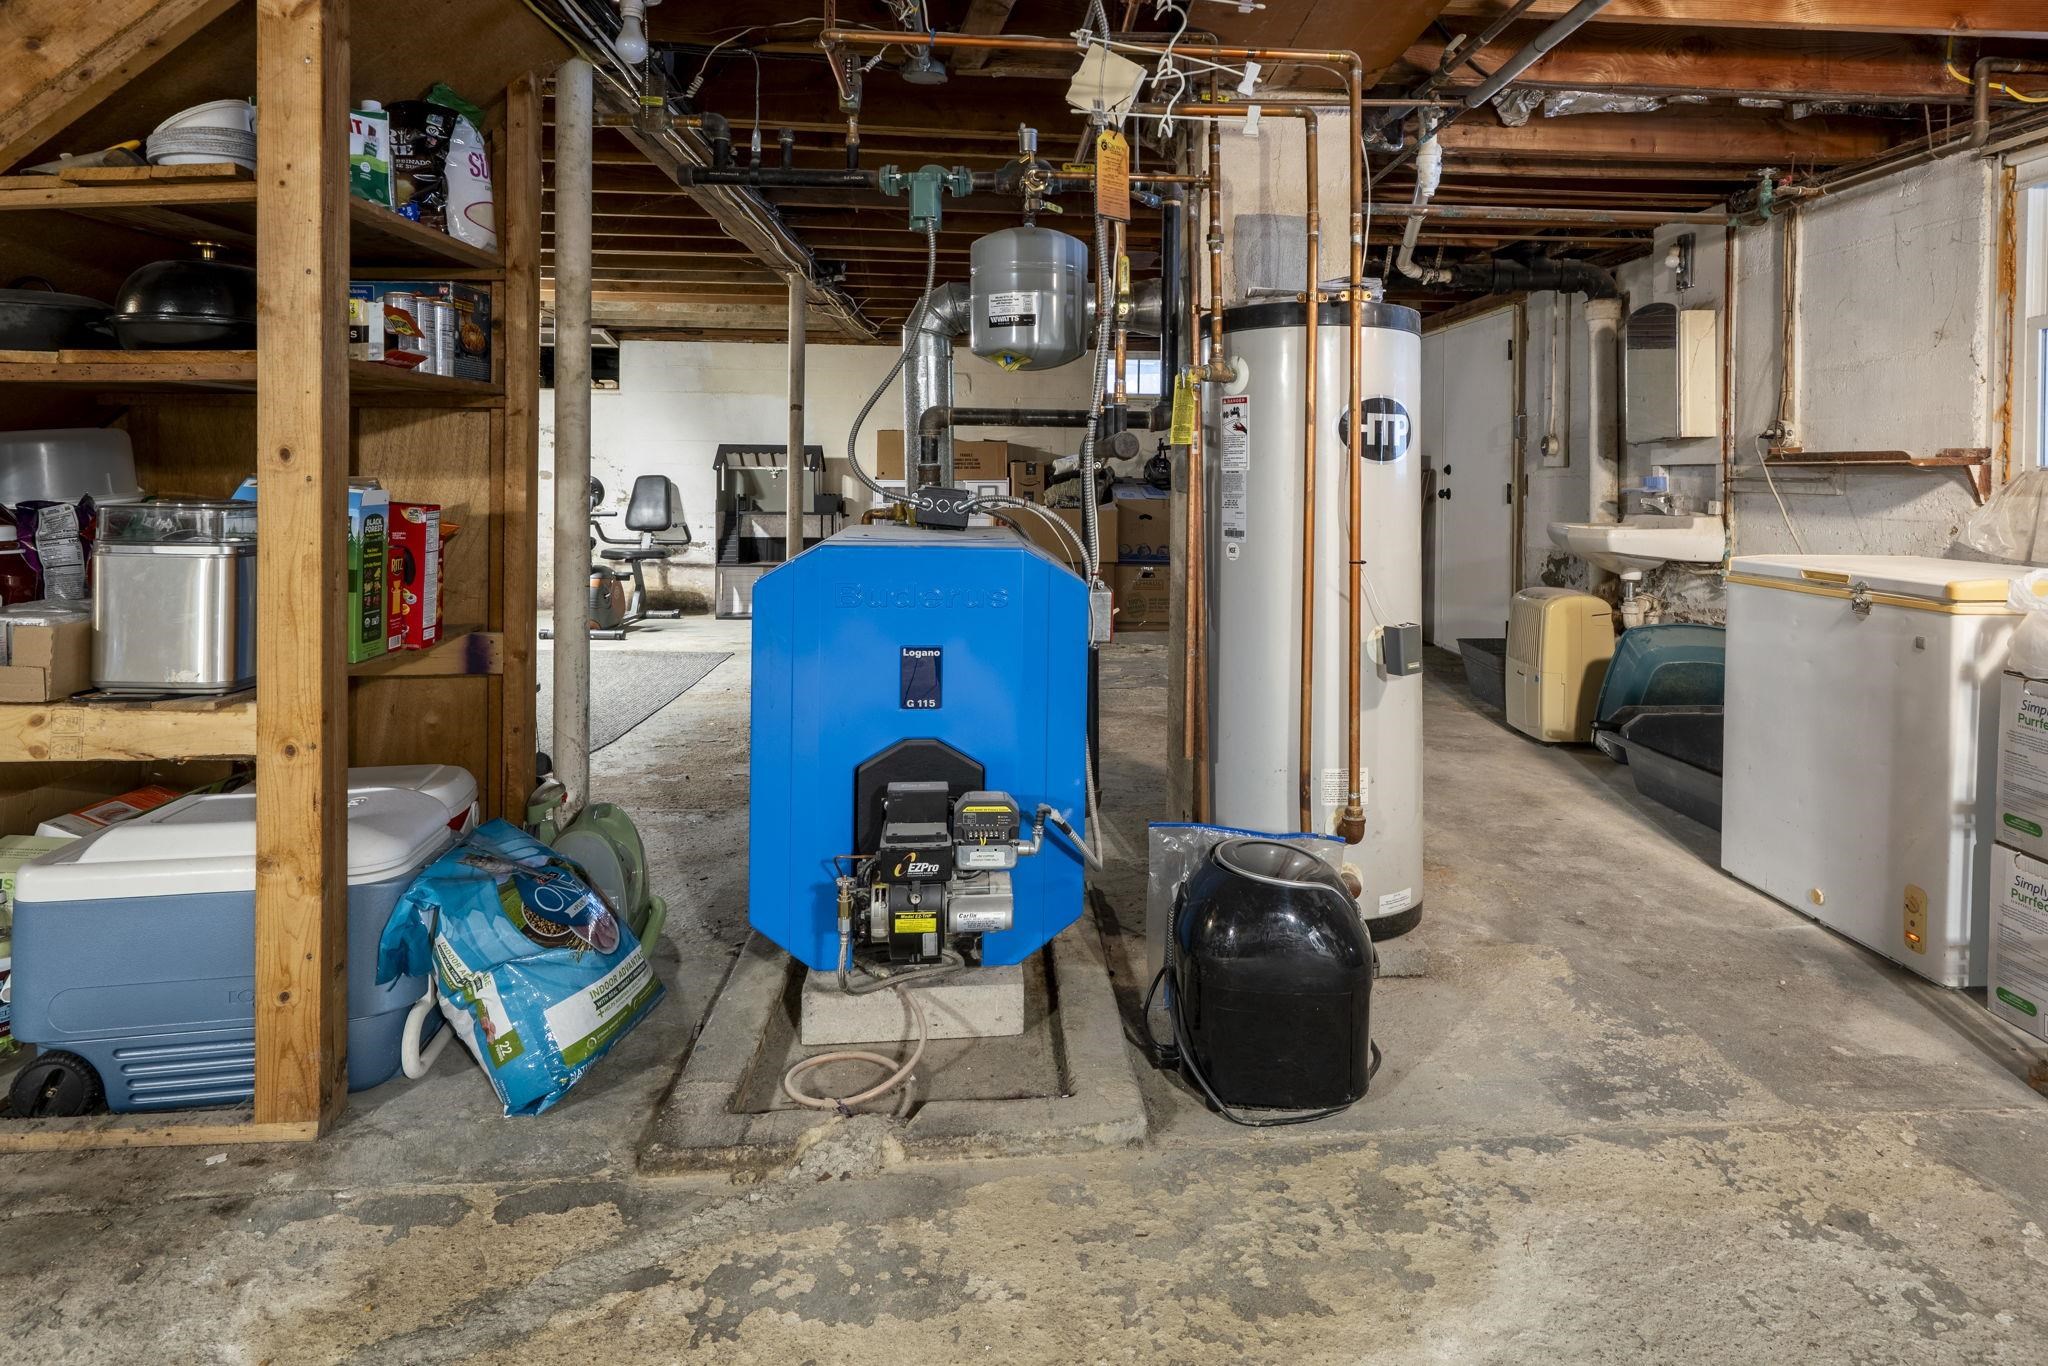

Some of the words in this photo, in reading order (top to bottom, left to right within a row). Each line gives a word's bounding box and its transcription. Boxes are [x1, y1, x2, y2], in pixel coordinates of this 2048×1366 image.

[366, 518, 382, 526] BLACK
[391, 558, 404, 572] RITZ
[902, 648, 941, 659] Logano
[906, 699, 914, 708] G
[917, 699, 936, 708] 115
[907, 862, 940, 873] EZPro
[440, 941, 462, 970] INDOOR
[589, 977, 618, 999] INDOOR
[596, 995, 609, 1007] WITH
[500, 1040, 513, 1057] 22
